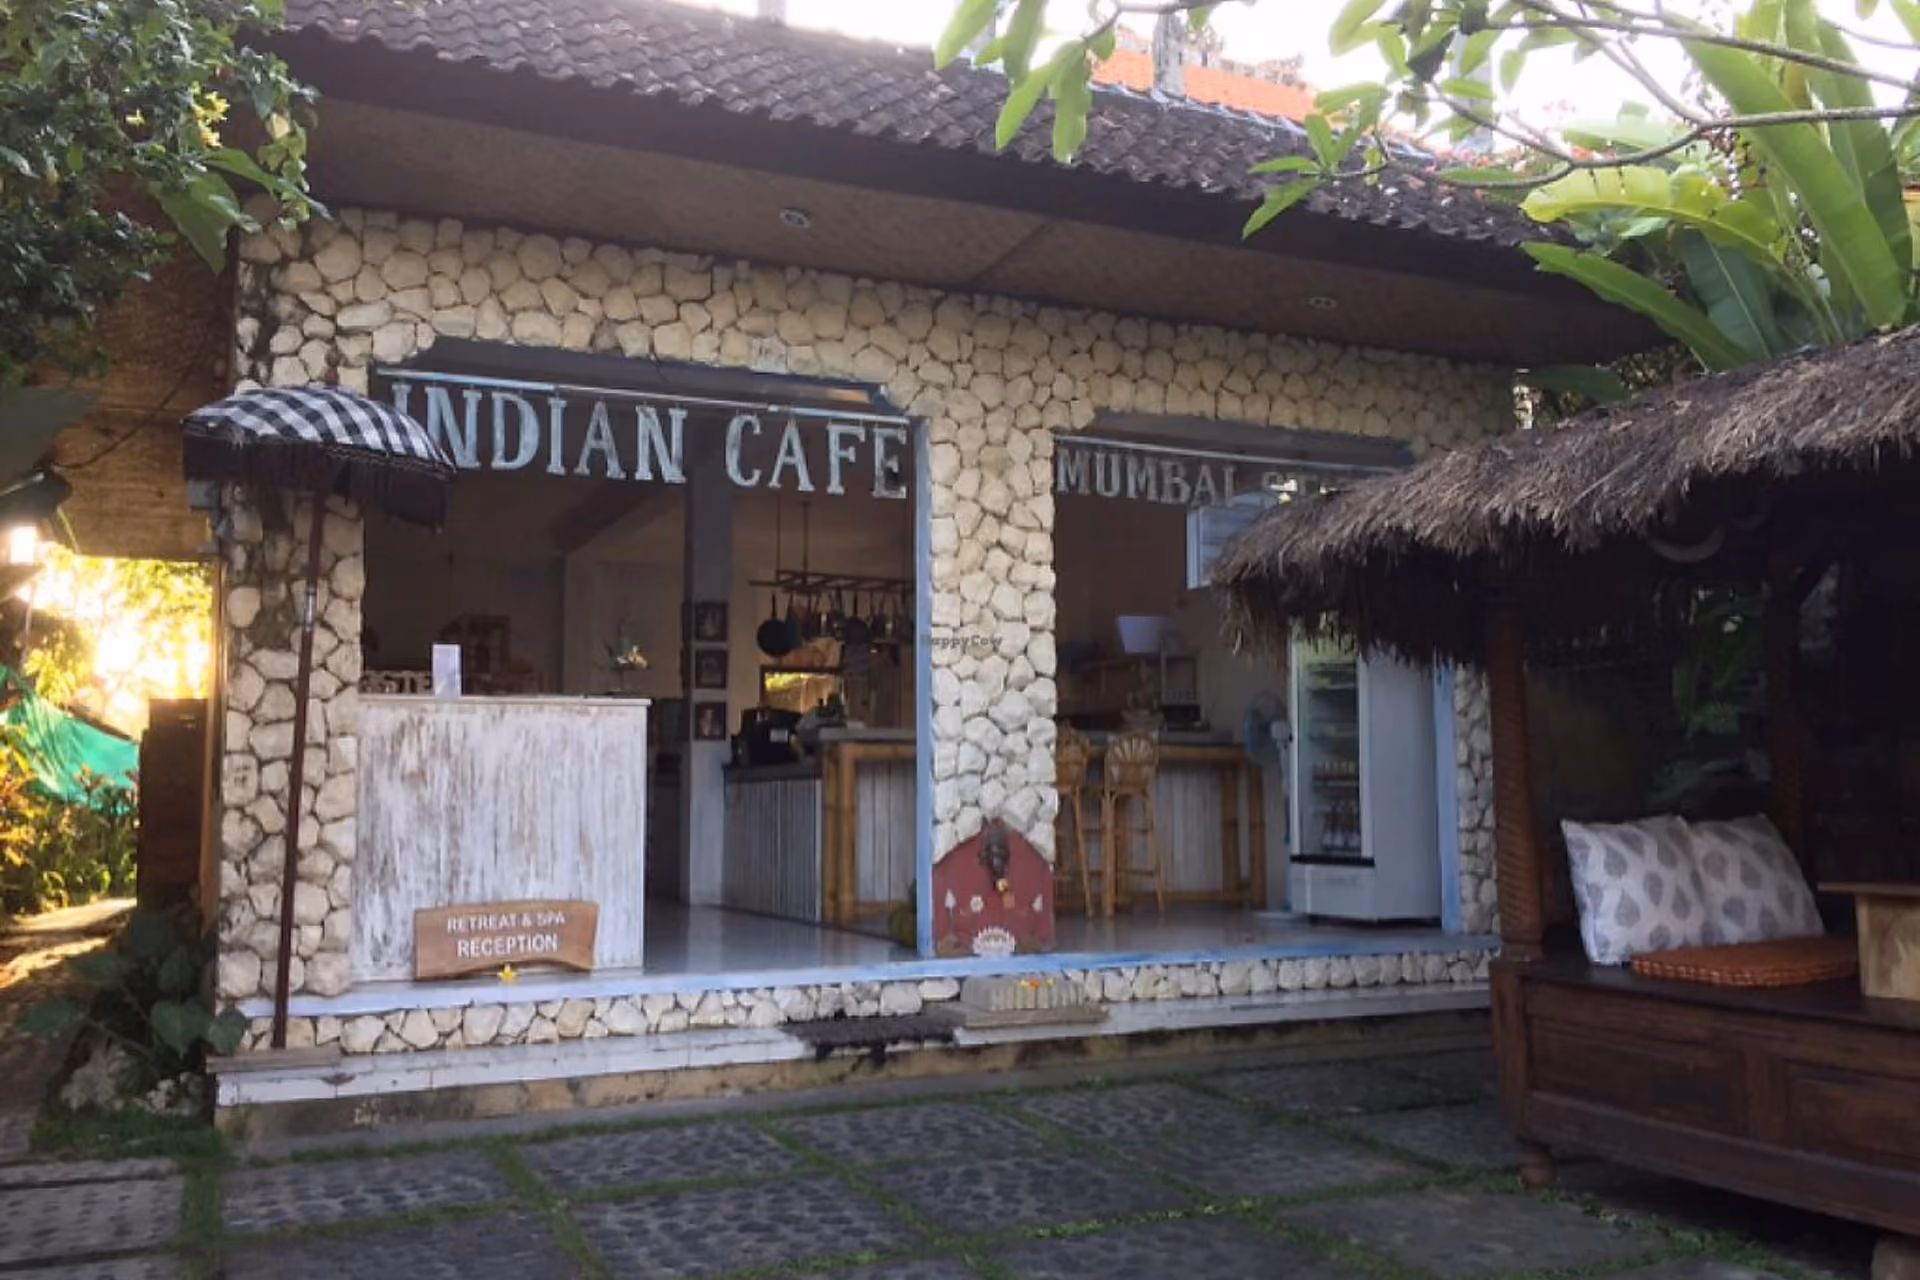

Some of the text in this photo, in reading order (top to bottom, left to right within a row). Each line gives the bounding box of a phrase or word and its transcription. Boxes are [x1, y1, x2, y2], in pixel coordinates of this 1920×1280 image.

[725, 413, 908, 499] CAFE
[1057, 448, 1237, 509] MUMBAI
[447, 910, 566, 933] RETREAT & SPA
[457, 933, 559, 957] RECEPTION
